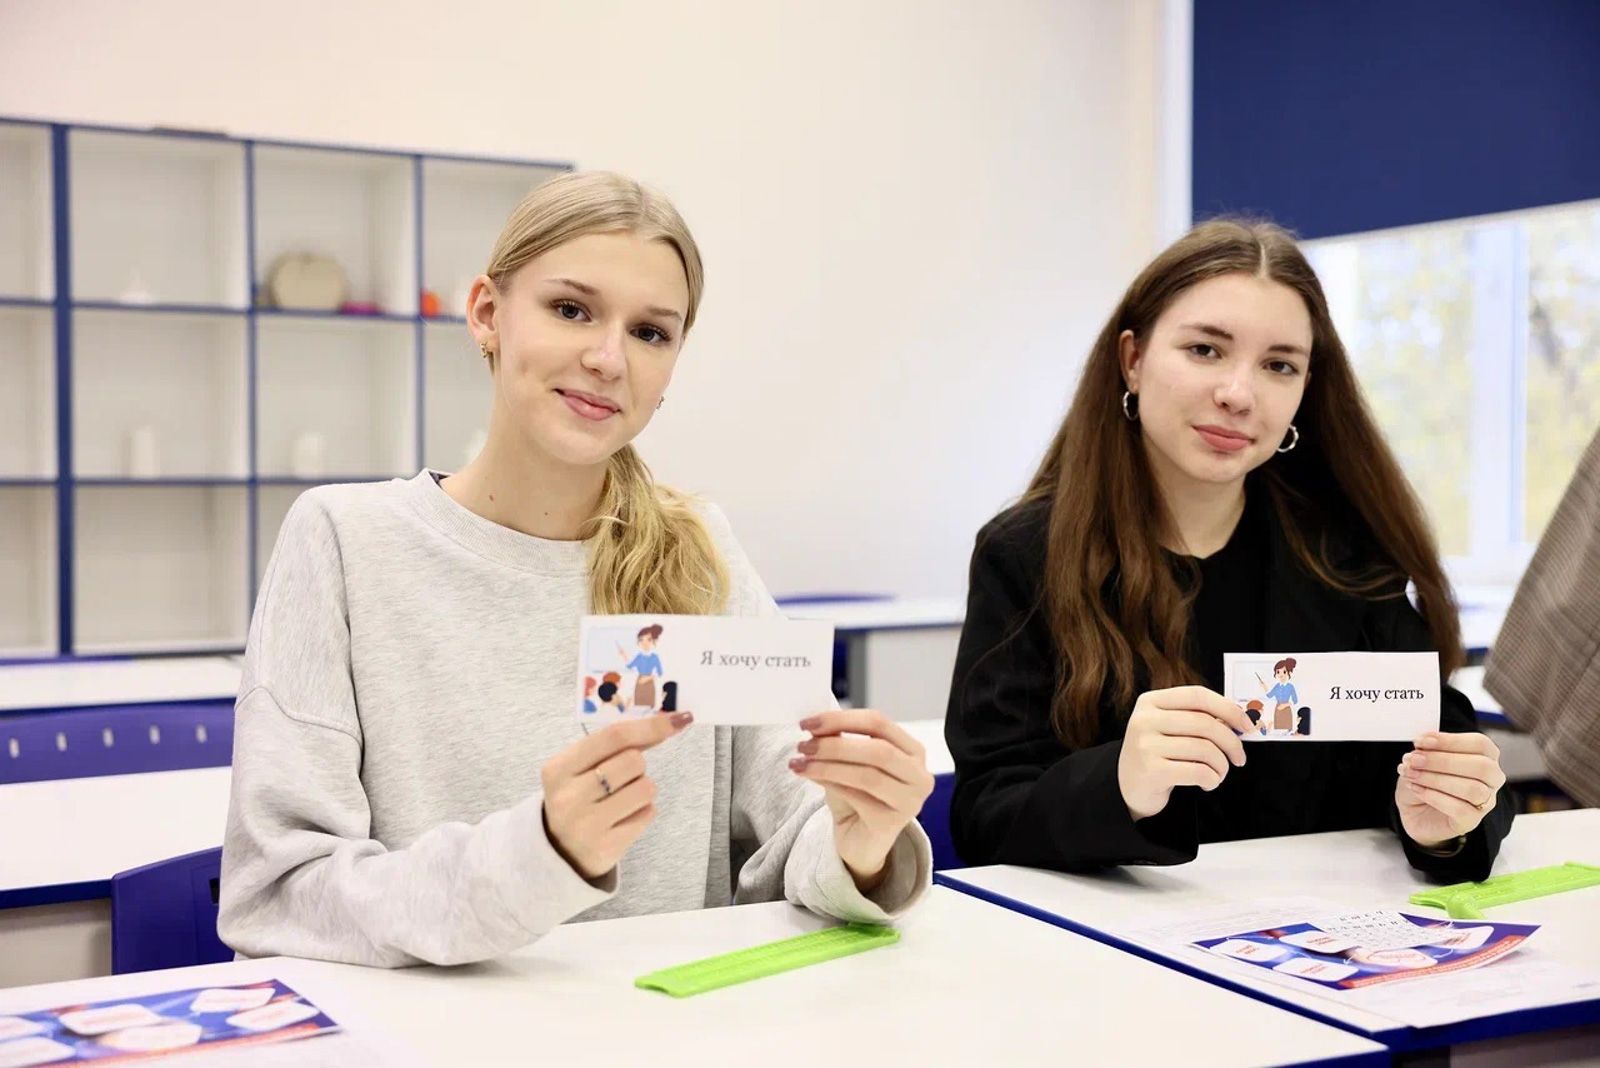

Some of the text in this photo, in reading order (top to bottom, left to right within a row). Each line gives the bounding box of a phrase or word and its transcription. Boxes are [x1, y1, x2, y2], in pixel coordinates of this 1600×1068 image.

[700, 650, 812, 671] Я хочу стать
[1328, 685, 1425, 703] Я хочу стать
